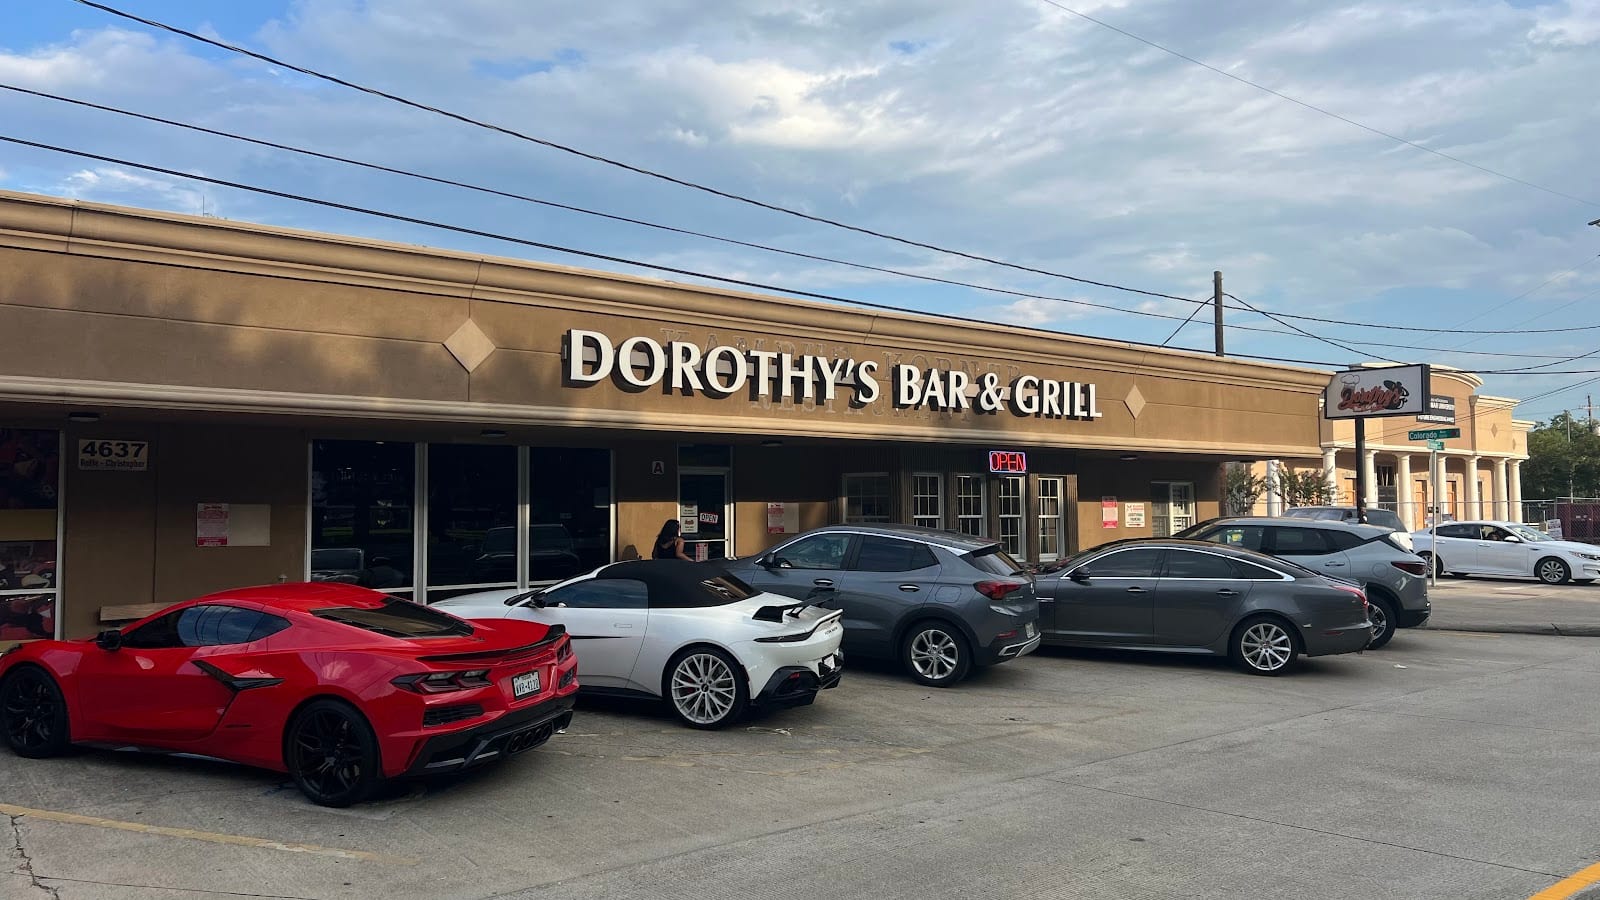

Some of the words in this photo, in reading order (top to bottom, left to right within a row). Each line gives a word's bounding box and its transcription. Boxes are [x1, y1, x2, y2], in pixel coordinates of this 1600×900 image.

[570, 329, 880, 403] DOROTHY'S
[898, 364, 970, 409] BAR
[979, 372, 1005, 411] &
[1014, 374, 1103, 419] GRILL
[1409, 432, 1437, 440] Colorado
[82, 441, 146, 457] 4637
[653, 462, 663, 474] A
[990, 452, 1026, 471] OPEN
[701, 513, 717, 523] OPEN
